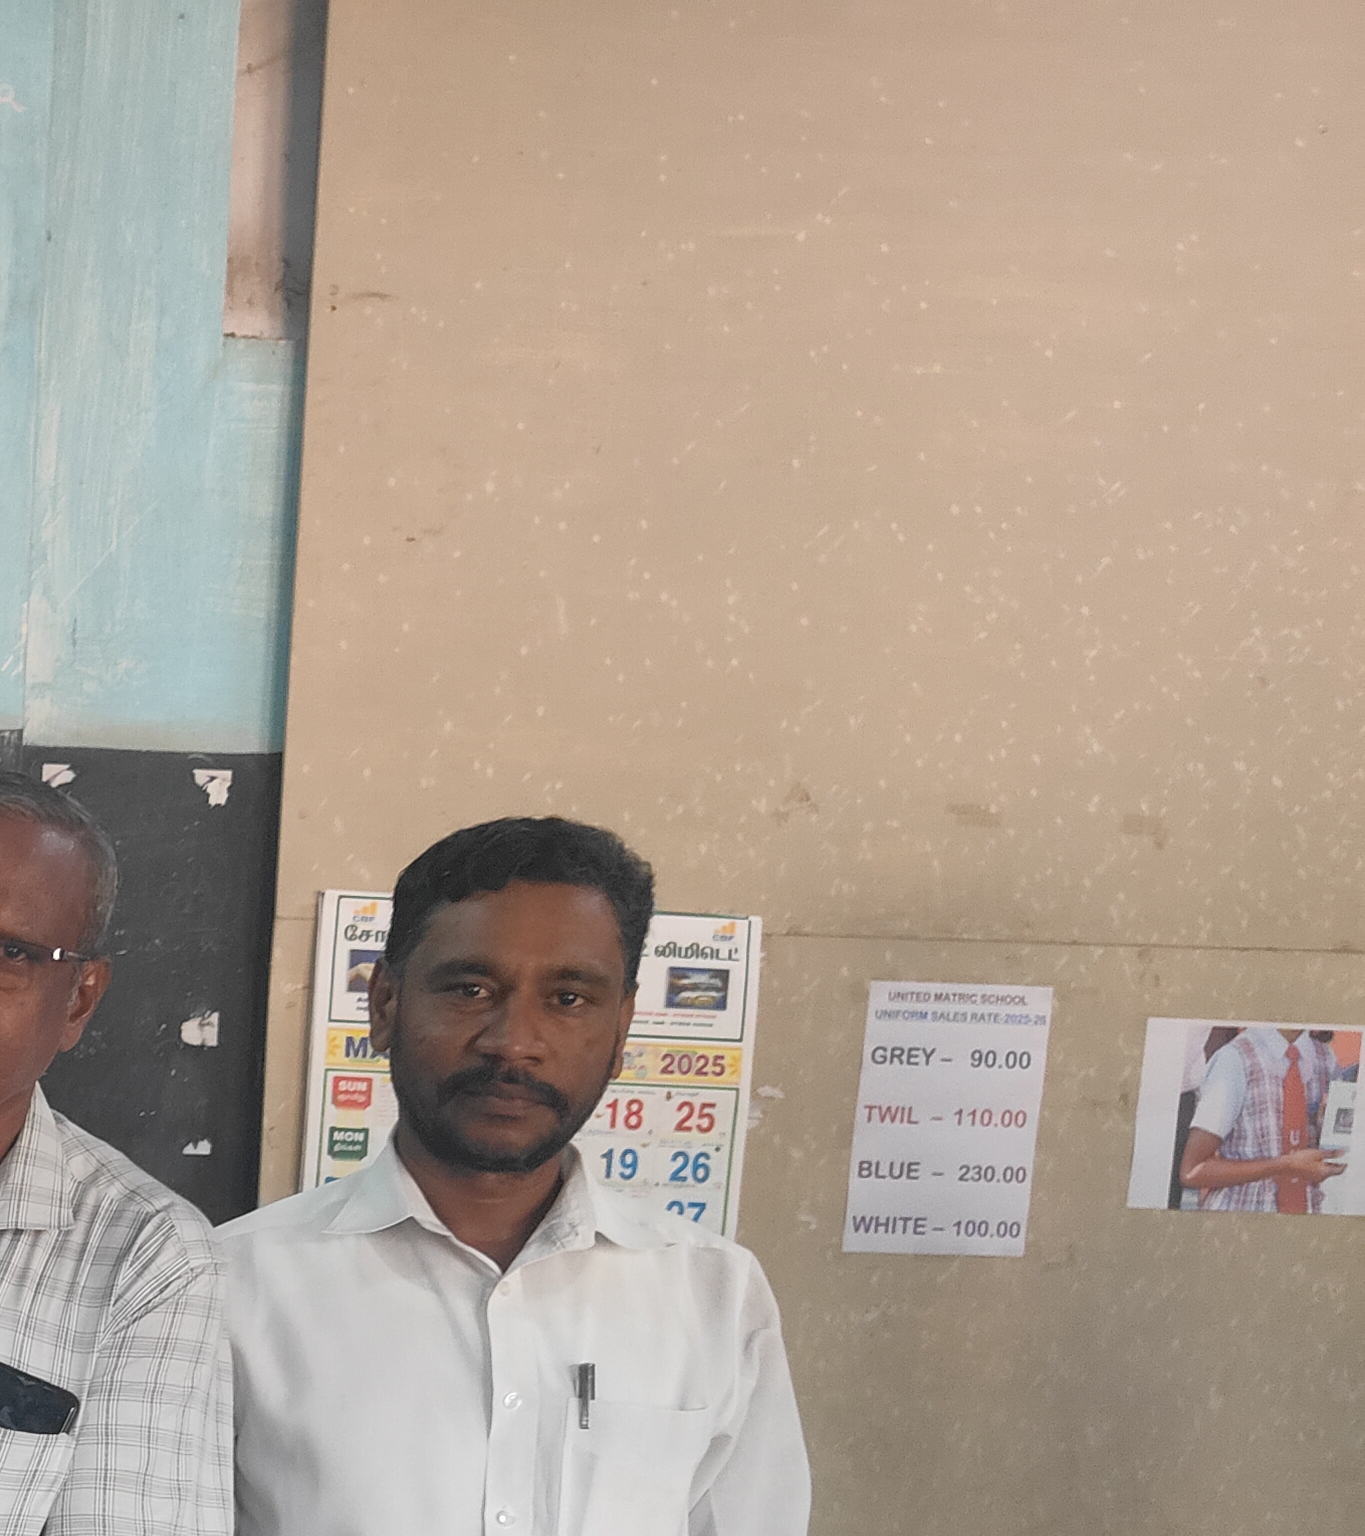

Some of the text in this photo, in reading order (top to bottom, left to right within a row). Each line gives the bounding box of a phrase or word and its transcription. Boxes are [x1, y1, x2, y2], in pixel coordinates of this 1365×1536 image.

[654, 941, 740, 962] லிமிடெட்
[888, 991, 1028, 1006] UNITED MATRIC SCHOOL
[875, 1009, 928, 1020] UNIFORM
[931, 1011, 967, 1022] SALES
[659, 1053, 726, 1077] 2025
[871, 1045, 936, 1067] GREY
[970, 1049, 1031, 1070] 90.00
[337, 1079, 368, 1092] SUN
[606, 1098, 717, 1134] 18 25
[864, 1105, 919, 1125] TWIL
[953, 1108, 1027, 1128] 110.00
[332, 1130, 365, 1142] MON
[600, 1148, 711, 1184] 19 26
[858, 1161, 921, 1181] BLUE
[958, 1165, 1027, 1184] 230.00
[852, 1215, 927, 1236] WHITE
[952, 1220, 1021, 1239] 100.00
